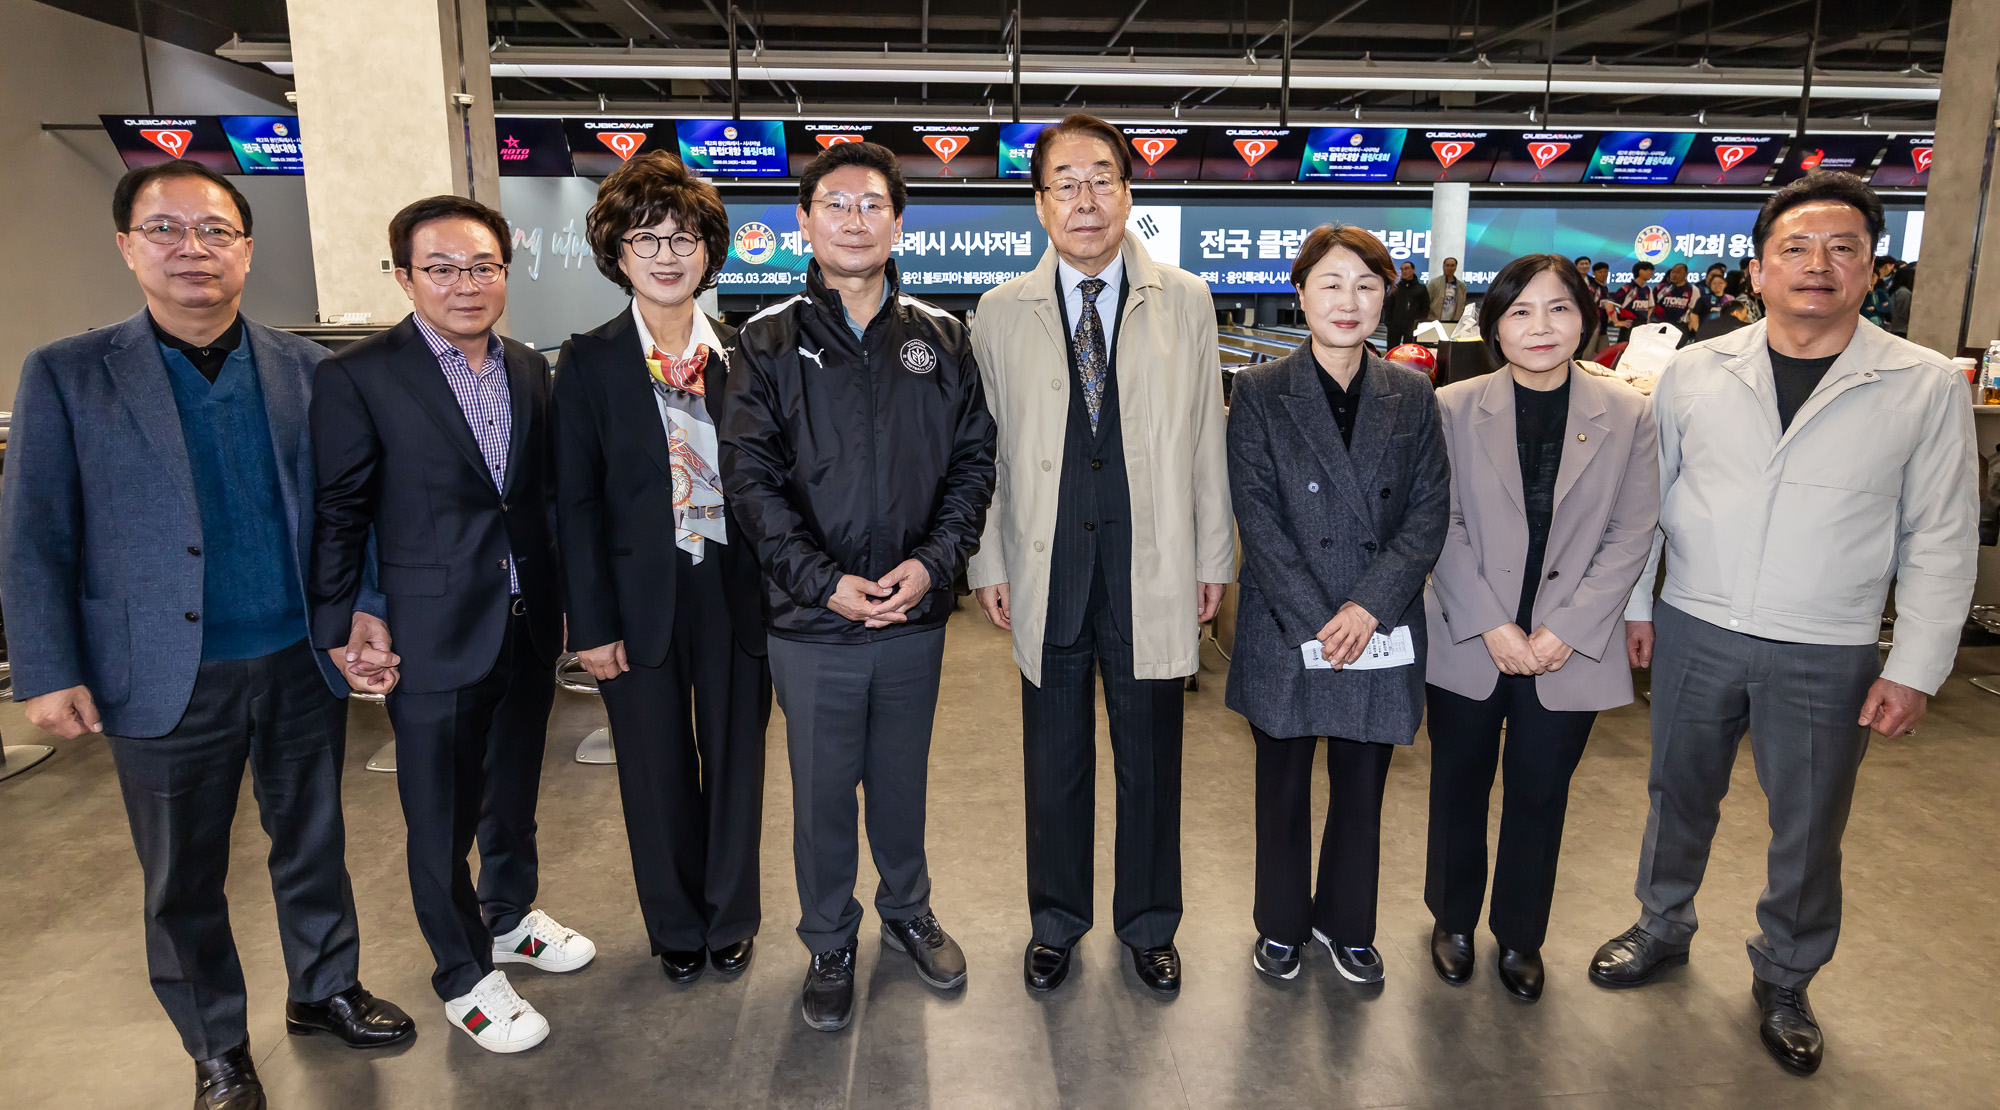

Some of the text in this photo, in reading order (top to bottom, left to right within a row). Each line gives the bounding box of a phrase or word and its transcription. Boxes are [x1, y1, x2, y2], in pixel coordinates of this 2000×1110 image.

[690, 146, 707, 156] 전국
[743, 146, 776, 156] 볼링대회
[1009, 148, 1025, 158] 전국
[1313, 152, 1328, 161] 전국
[780, 230, 813, 256] 제
[950, 231, 1032, 256] 시사저널
[1200, 228, 1252, 259] 전국
[1256, 228, 1310, 259] 클럽
[1674, 233, 1725, 258] 제2회
[901, 271, 922, 285] 용인
[923, 271, 962, 285] 볼토피아
